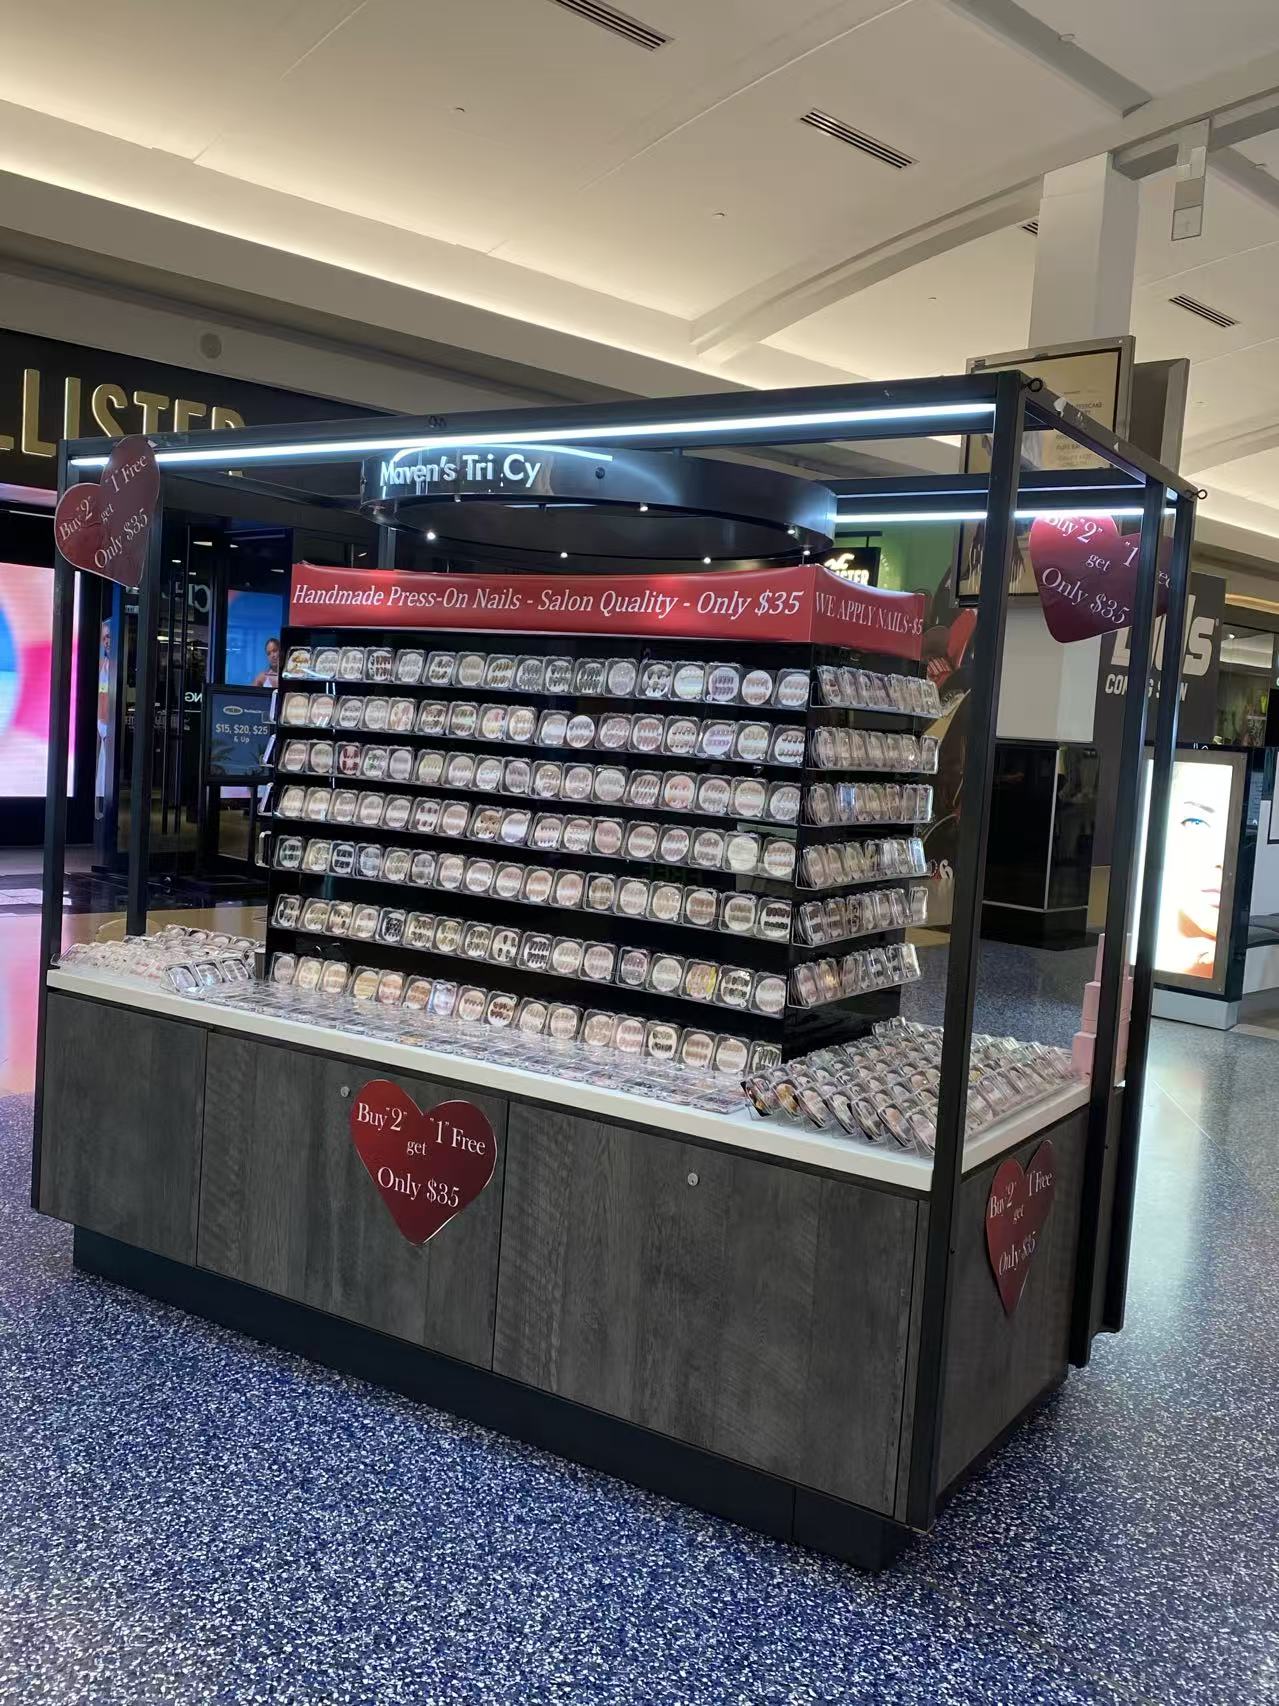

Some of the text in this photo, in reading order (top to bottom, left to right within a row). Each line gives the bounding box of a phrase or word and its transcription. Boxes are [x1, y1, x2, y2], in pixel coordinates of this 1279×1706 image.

[121, 454, 148, 484] Free
[380, 453, 543, 487] Maven's Tri Cy
[100, 503, 114, 523] get
[59, 516, 83, 542] Buy
[94, 507, 149, 569] Only $35
[1085, 553, 1111, 572] get
[292, 584, 384, 606] Handmade
[387, 586, 469, 610] Press-On
[472, 588, 522, 610] Nails
[538, 590, 593, 612] Salon
[599, 591, 679, 619] Quality
[697, 590, 752, 620] Only
[755, 589, 805, 616] $35
[815, 591, 836, 618] WE
[837, 600, 876, 627] APPLY
[1042, 567, 1130, 624] Only $35
[240, 735, 250, 744] Up
[252, 724, 269, 735] $25
[357, 1102, 388, 1131] Buy
[406, 1140, 427, 1156] get
[451, 1127, 486, 1156] Free
[377, 1166, 460, 1208] Only $35
[989, 1195, 1005, 1218] Buy
[998, 1244, 1021, 1276] Only
